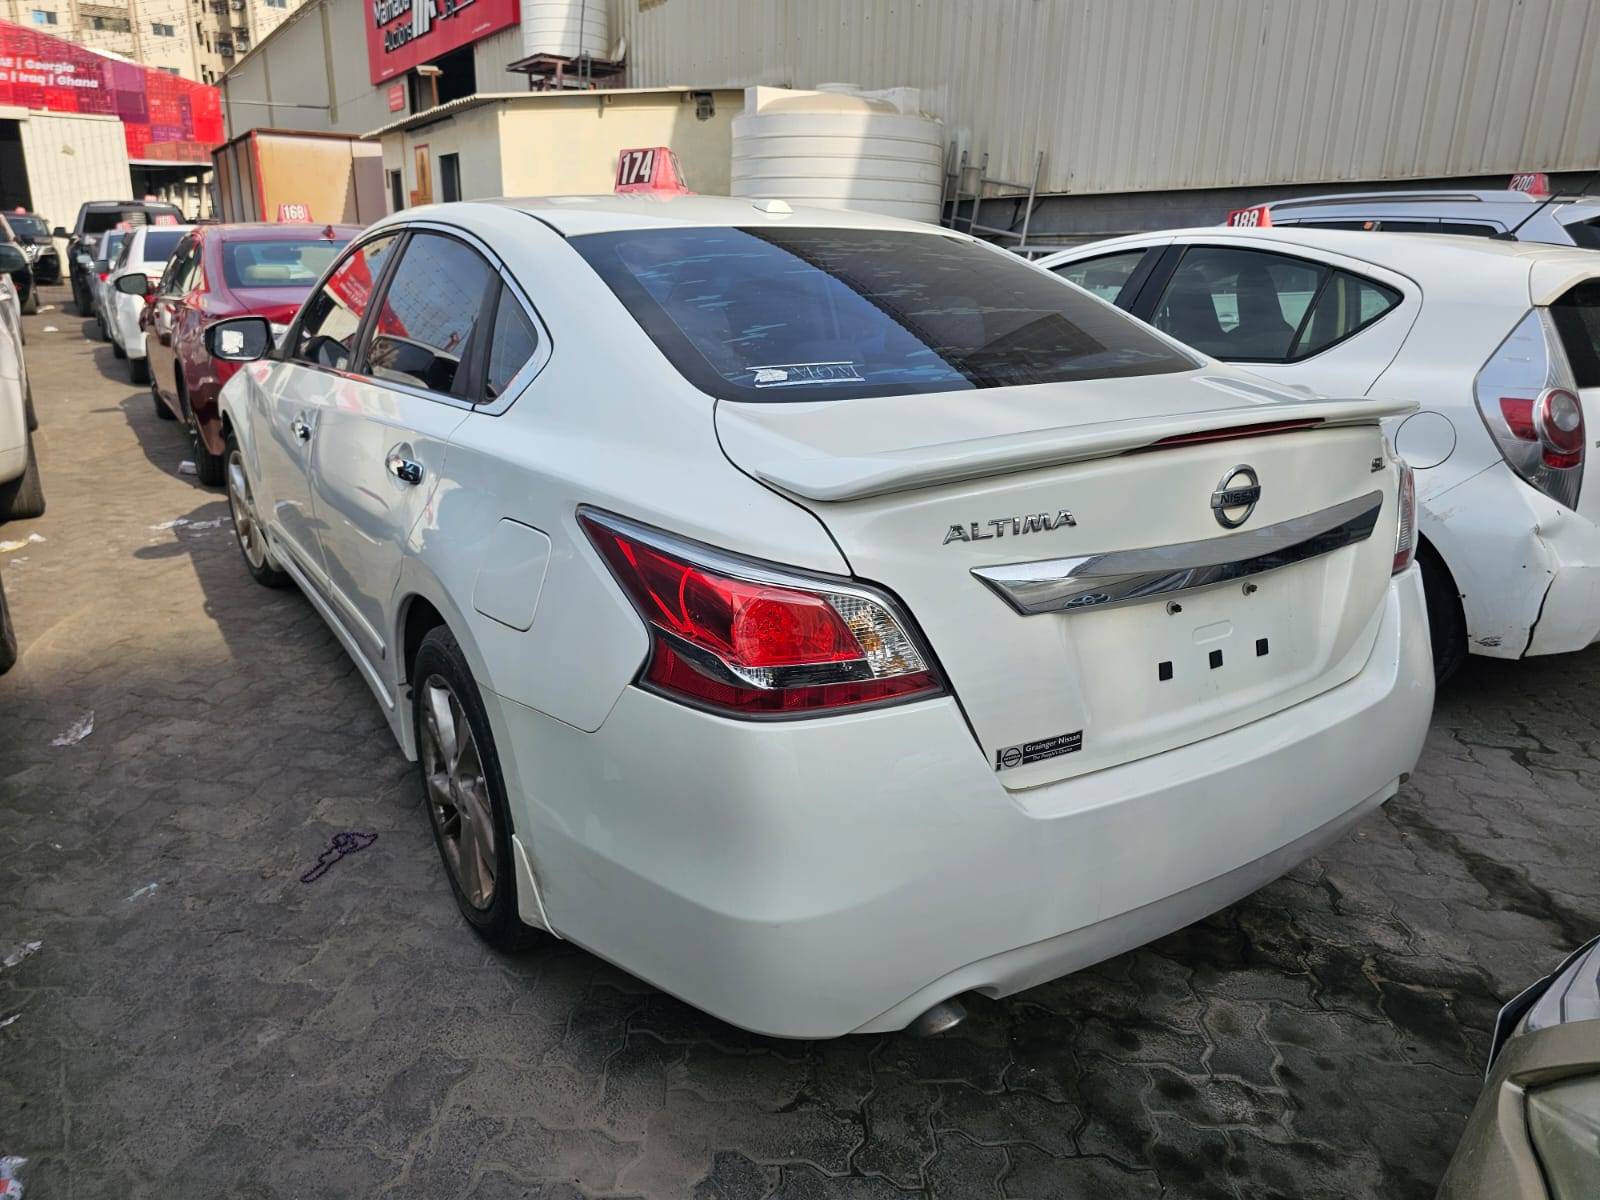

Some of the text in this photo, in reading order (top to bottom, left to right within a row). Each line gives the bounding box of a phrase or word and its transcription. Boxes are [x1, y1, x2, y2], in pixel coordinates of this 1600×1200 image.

[384, 23, 413, 51] Auctions
[25, 60, 75, 74] Georgia
[19, 72, 46, 87] Iraq
[57, 76, 99, 88] Ghana
[621, 150, 654, 185] 174
[1510, 174, 1536, 191] 200
[283, 204, 305, 220] 168
[1233, 209, 1259, 228] 188
[942, 509, 1077, 545] ALTIMA
[1025, 734, 1081, 752] Grainger Nissan
